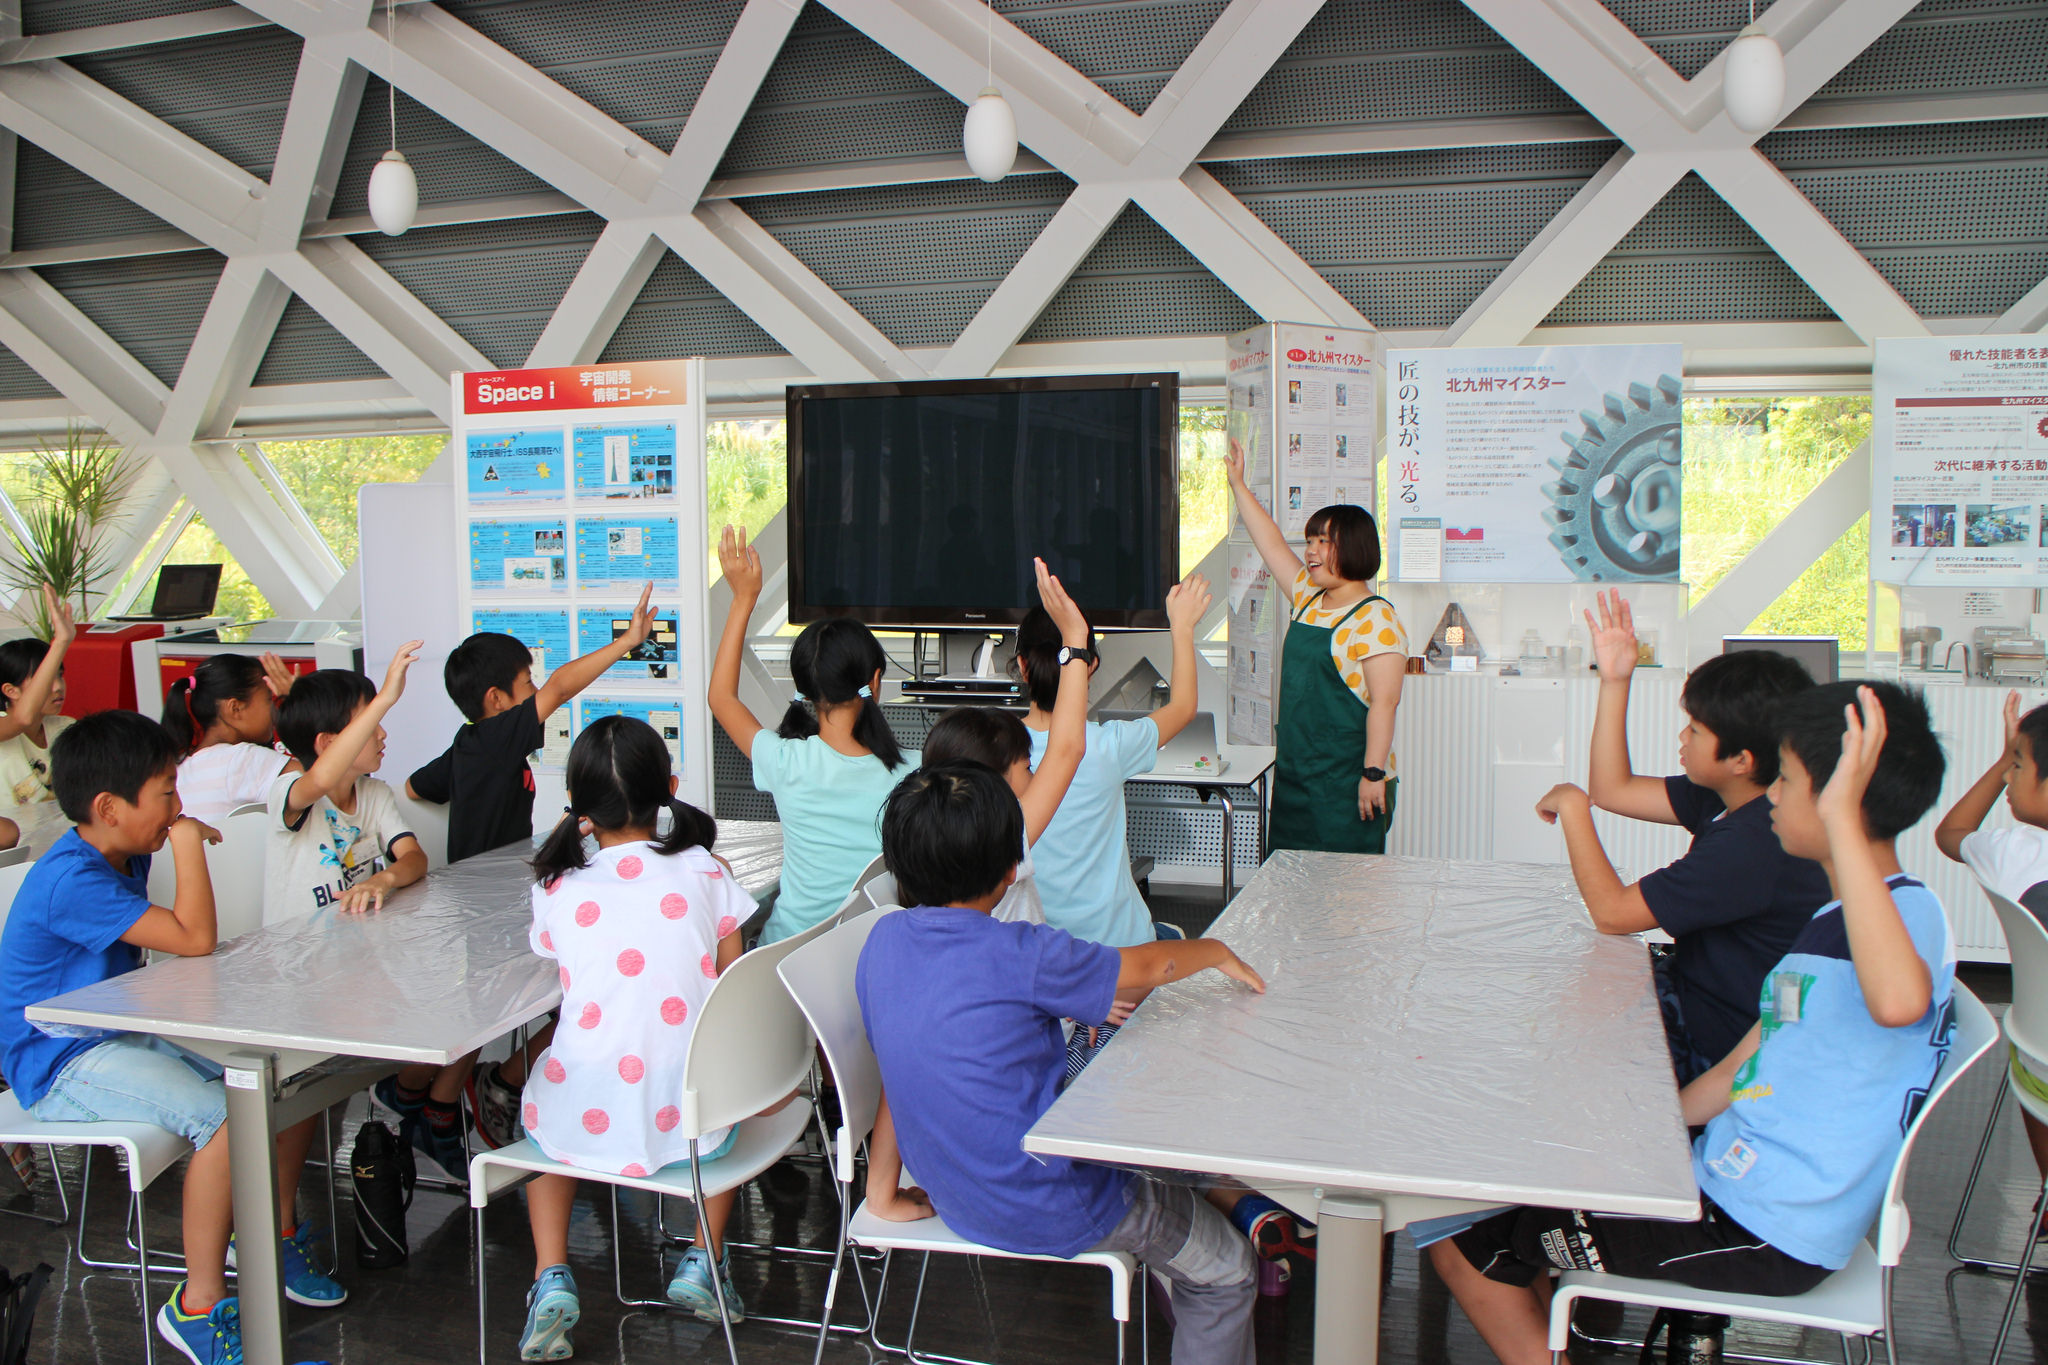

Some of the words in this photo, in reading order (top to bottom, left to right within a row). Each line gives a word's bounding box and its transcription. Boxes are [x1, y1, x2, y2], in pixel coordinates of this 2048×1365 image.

[1308, 350, 1371, 367] 北九州マイスター
[579, 369, 632, 387] 宇宙開発
[1446, 376, 1566, 393] 北九州マイスター
[478, 384, 543, 405] Space
[549, 381, 555, 400] i
[592, 387, 671, 403] 情報コーナー
[1398, 360, 1420, 512] 匠の技が、光る。
[1934, 459, 2048, 472] 次代に継承する活動
